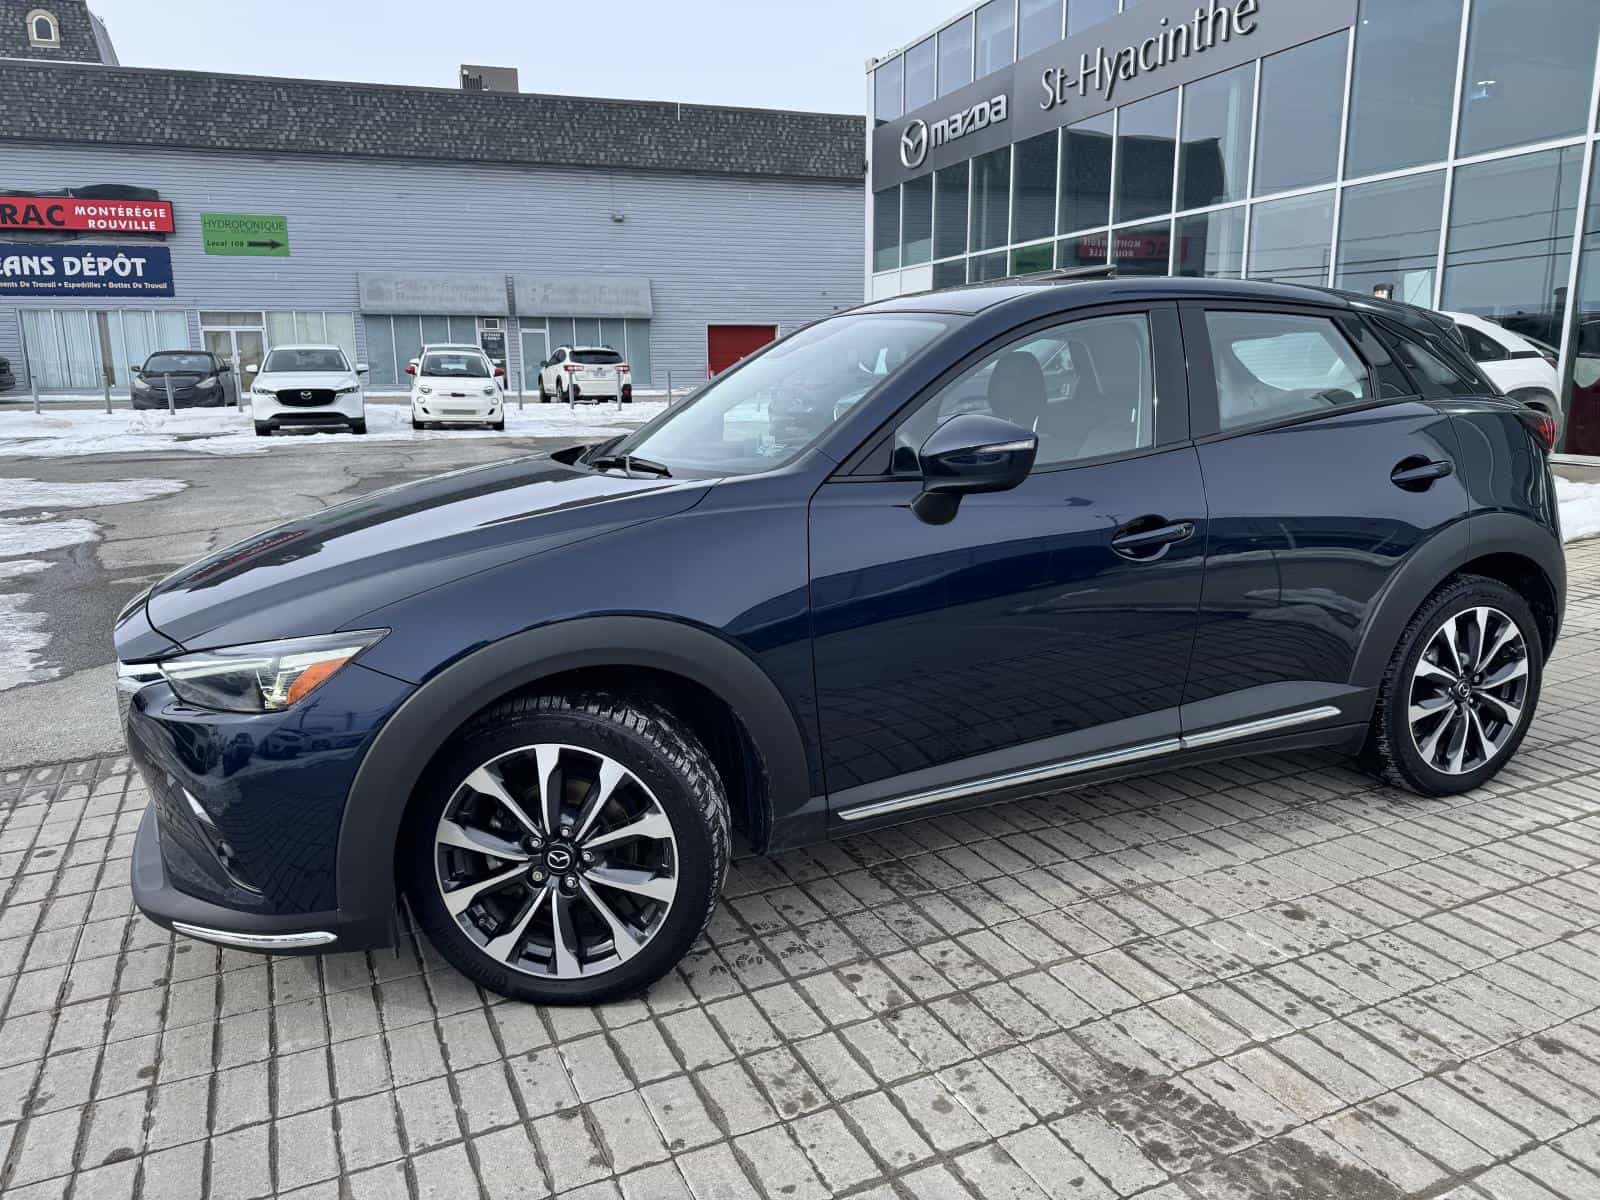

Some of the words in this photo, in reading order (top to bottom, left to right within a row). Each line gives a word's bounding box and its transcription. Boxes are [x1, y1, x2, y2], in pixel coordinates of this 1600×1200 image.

[1039, 0, 1259, 110] St-Hyacinthe
[74, 205, 167, 218] MONTÉRÉGIE
[87, 219, 157, 230] ROUVILLE
[203, 218, 285, 231] HYDROPONIQUE
[0, 255, 55, 277] ANS
[62, 252, 147, 277] DÉPÔT
